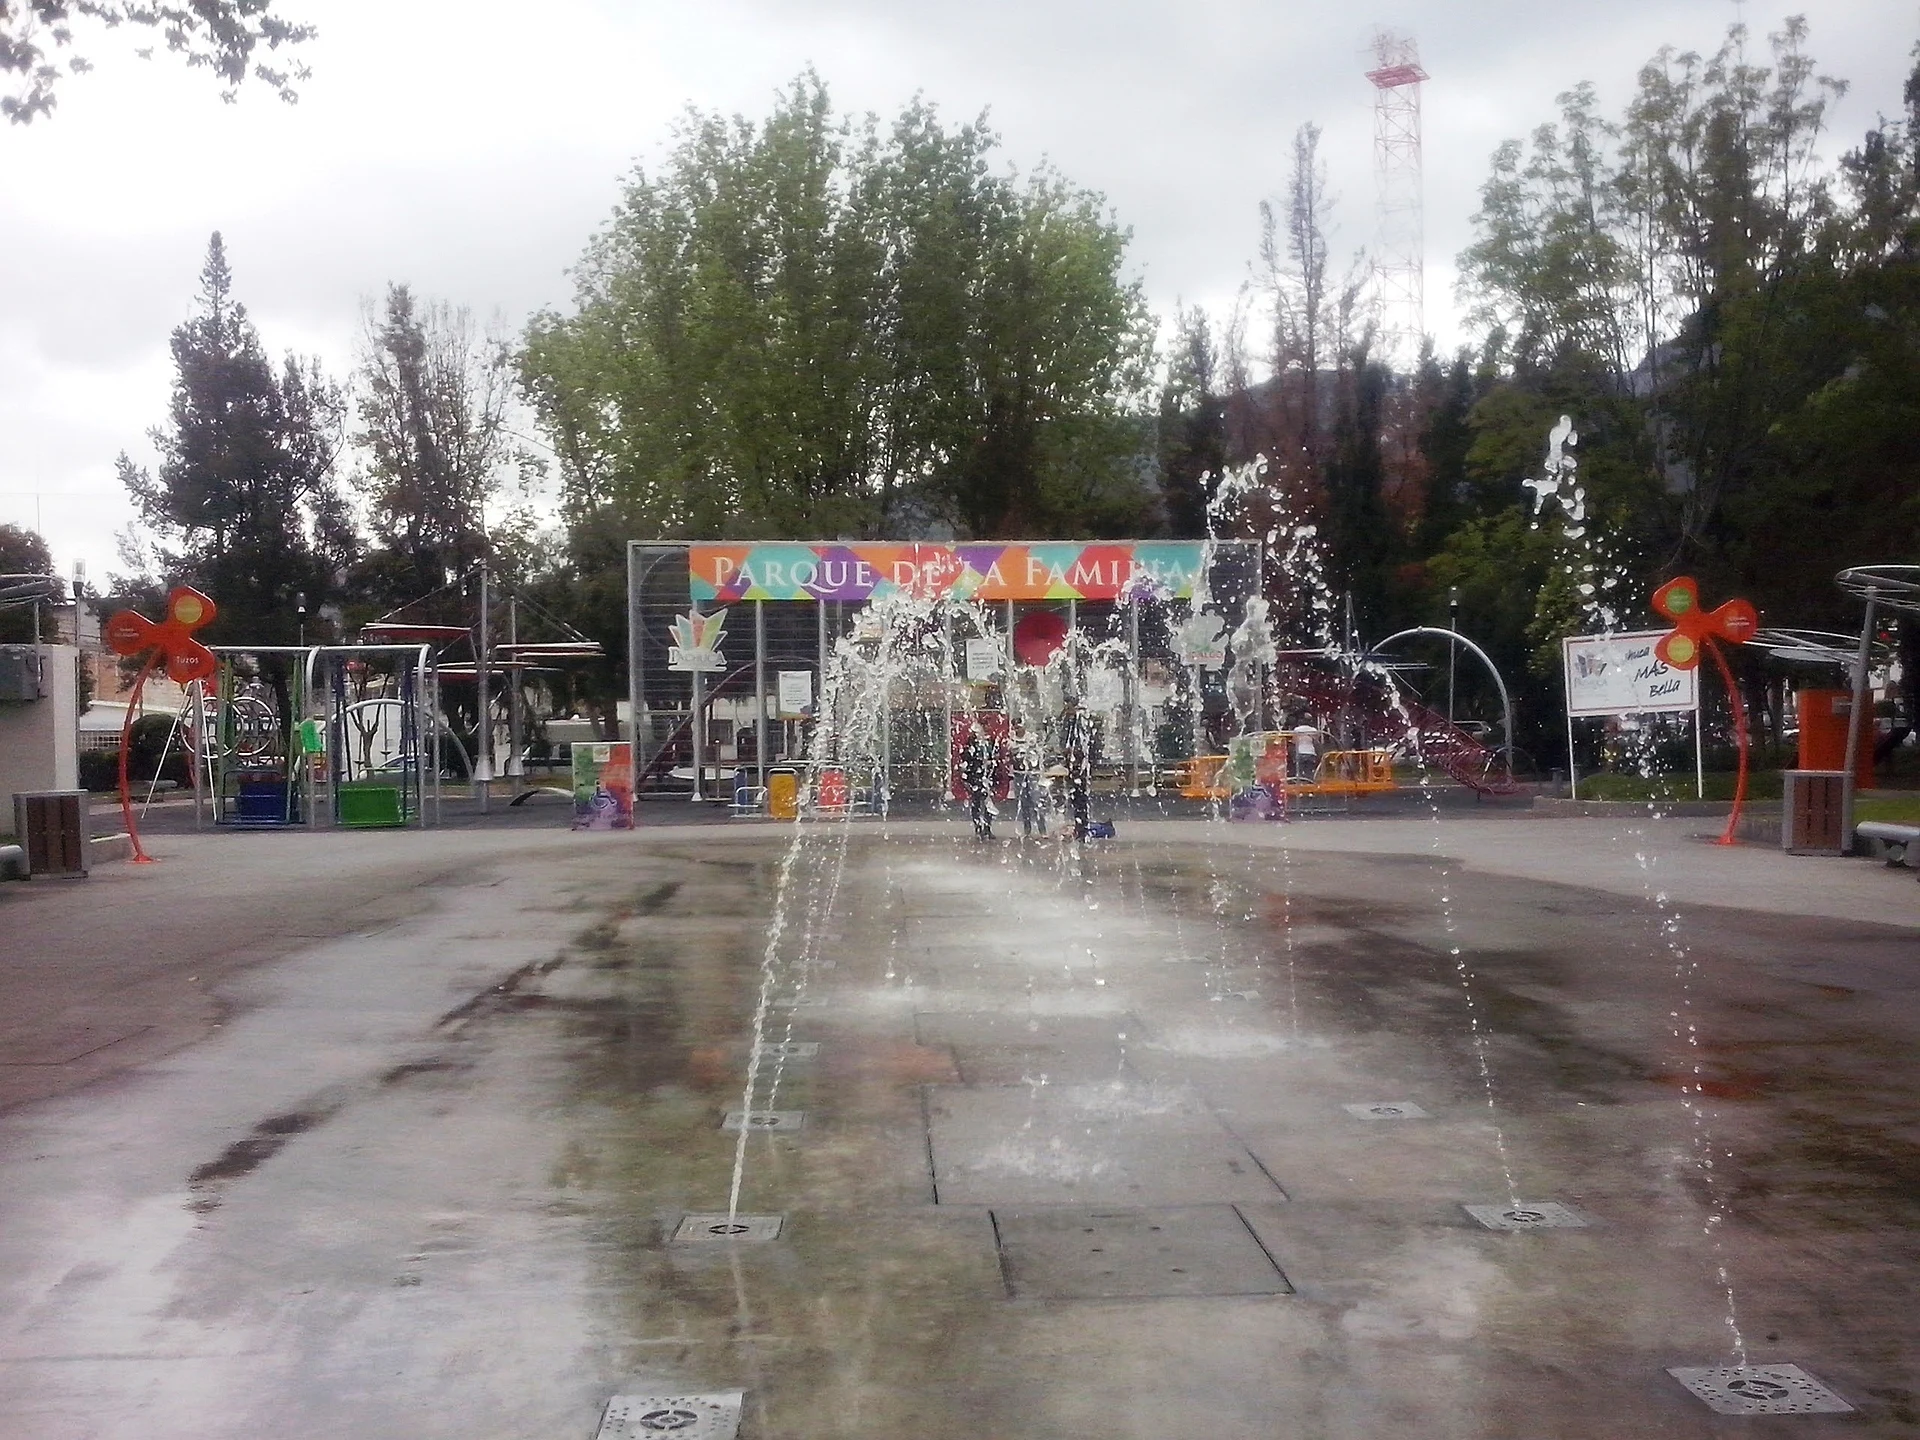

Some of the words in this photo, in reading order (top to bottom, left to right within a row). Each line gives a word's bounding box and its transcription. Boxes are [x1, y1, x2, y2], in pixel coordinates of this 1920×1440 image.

[713, 556, 873, 593] PARQUE
[891, 560, 942, 587] DE
[1649, 679, 1681, 698] Bella
